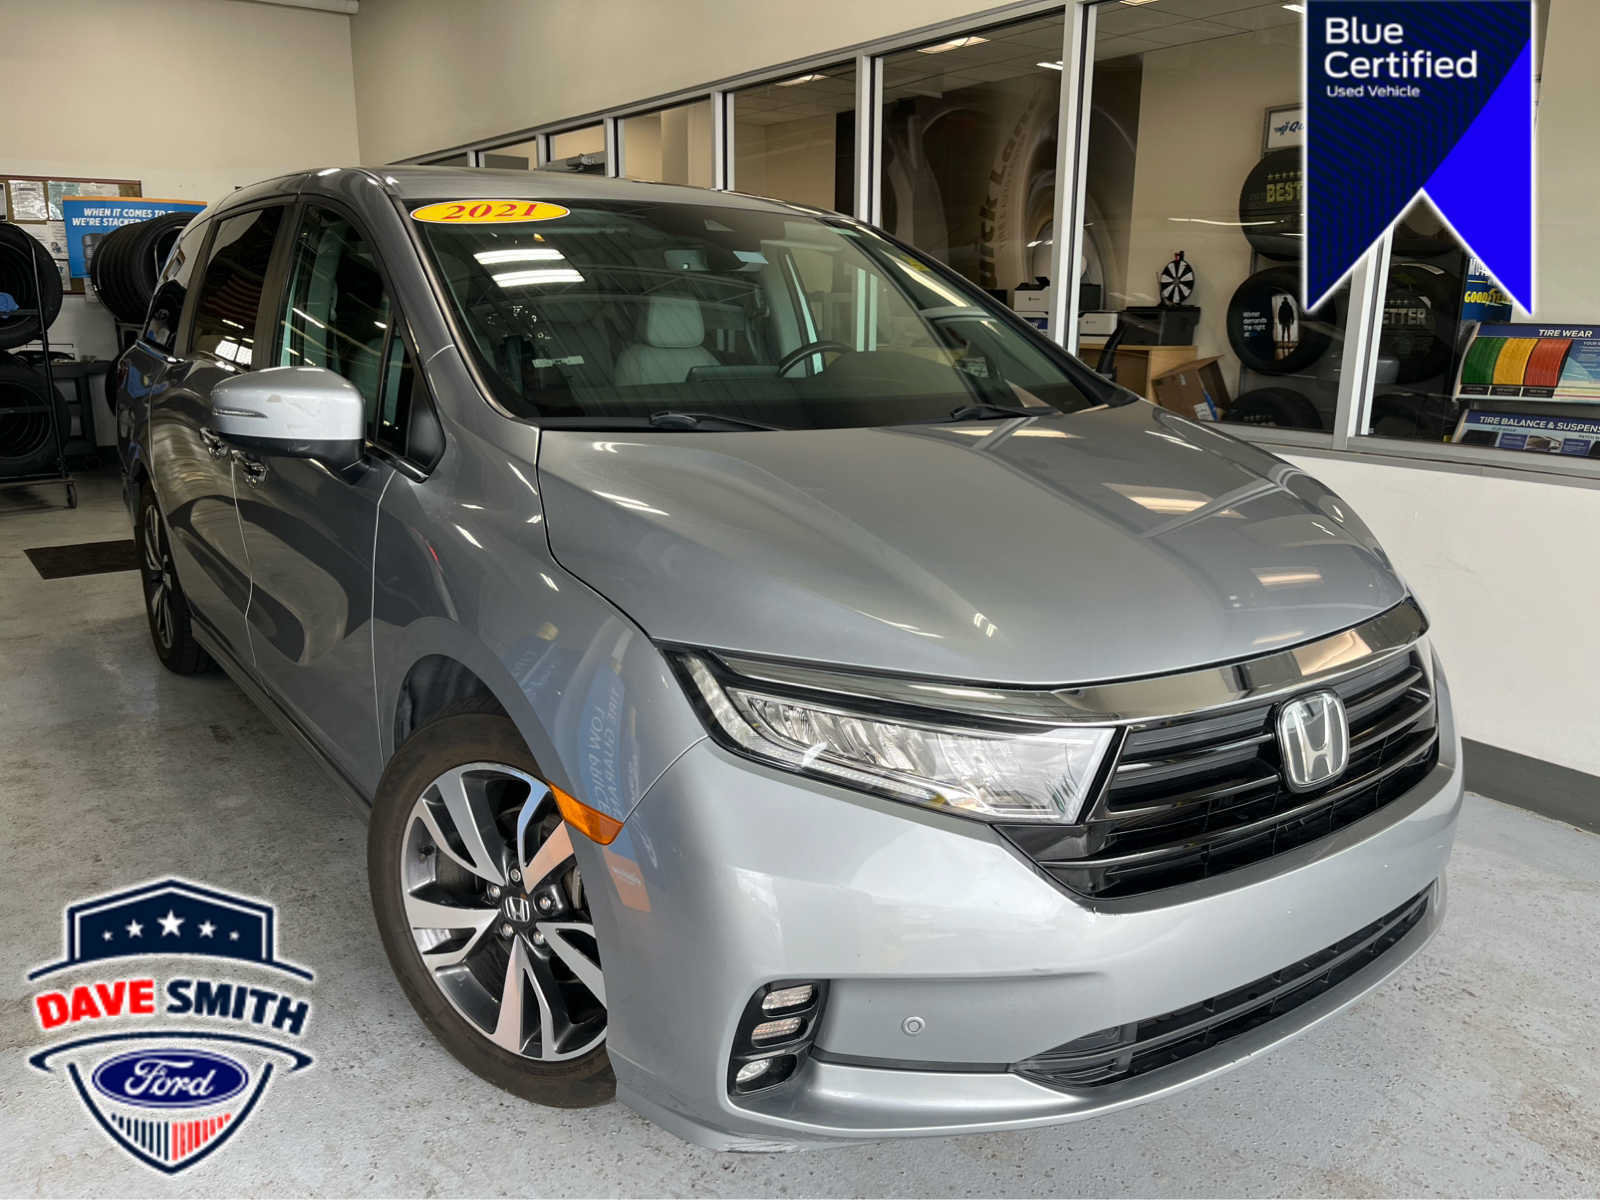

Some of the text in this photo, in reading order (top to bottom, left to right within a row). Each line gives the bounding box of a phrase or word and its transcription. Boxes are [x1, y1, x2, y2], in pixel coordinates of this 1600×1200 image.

[83, 207, 111, 217] WHEN
[112, 208, 121, 217] IT
[122, 208, 153, 218] COMES
[441, 203, 537, 220] 2021
[72, 217, 101, 227] WE'RE
[1384, 308, 1425, 325] ETTER
[1538, 328, 1593, 338] TIRE WEAR
[1479, 416, 1500, 425] TIRE
[1501, 417, 1546, 429] BALANCE
[1547, 421, 1555, 429] &
